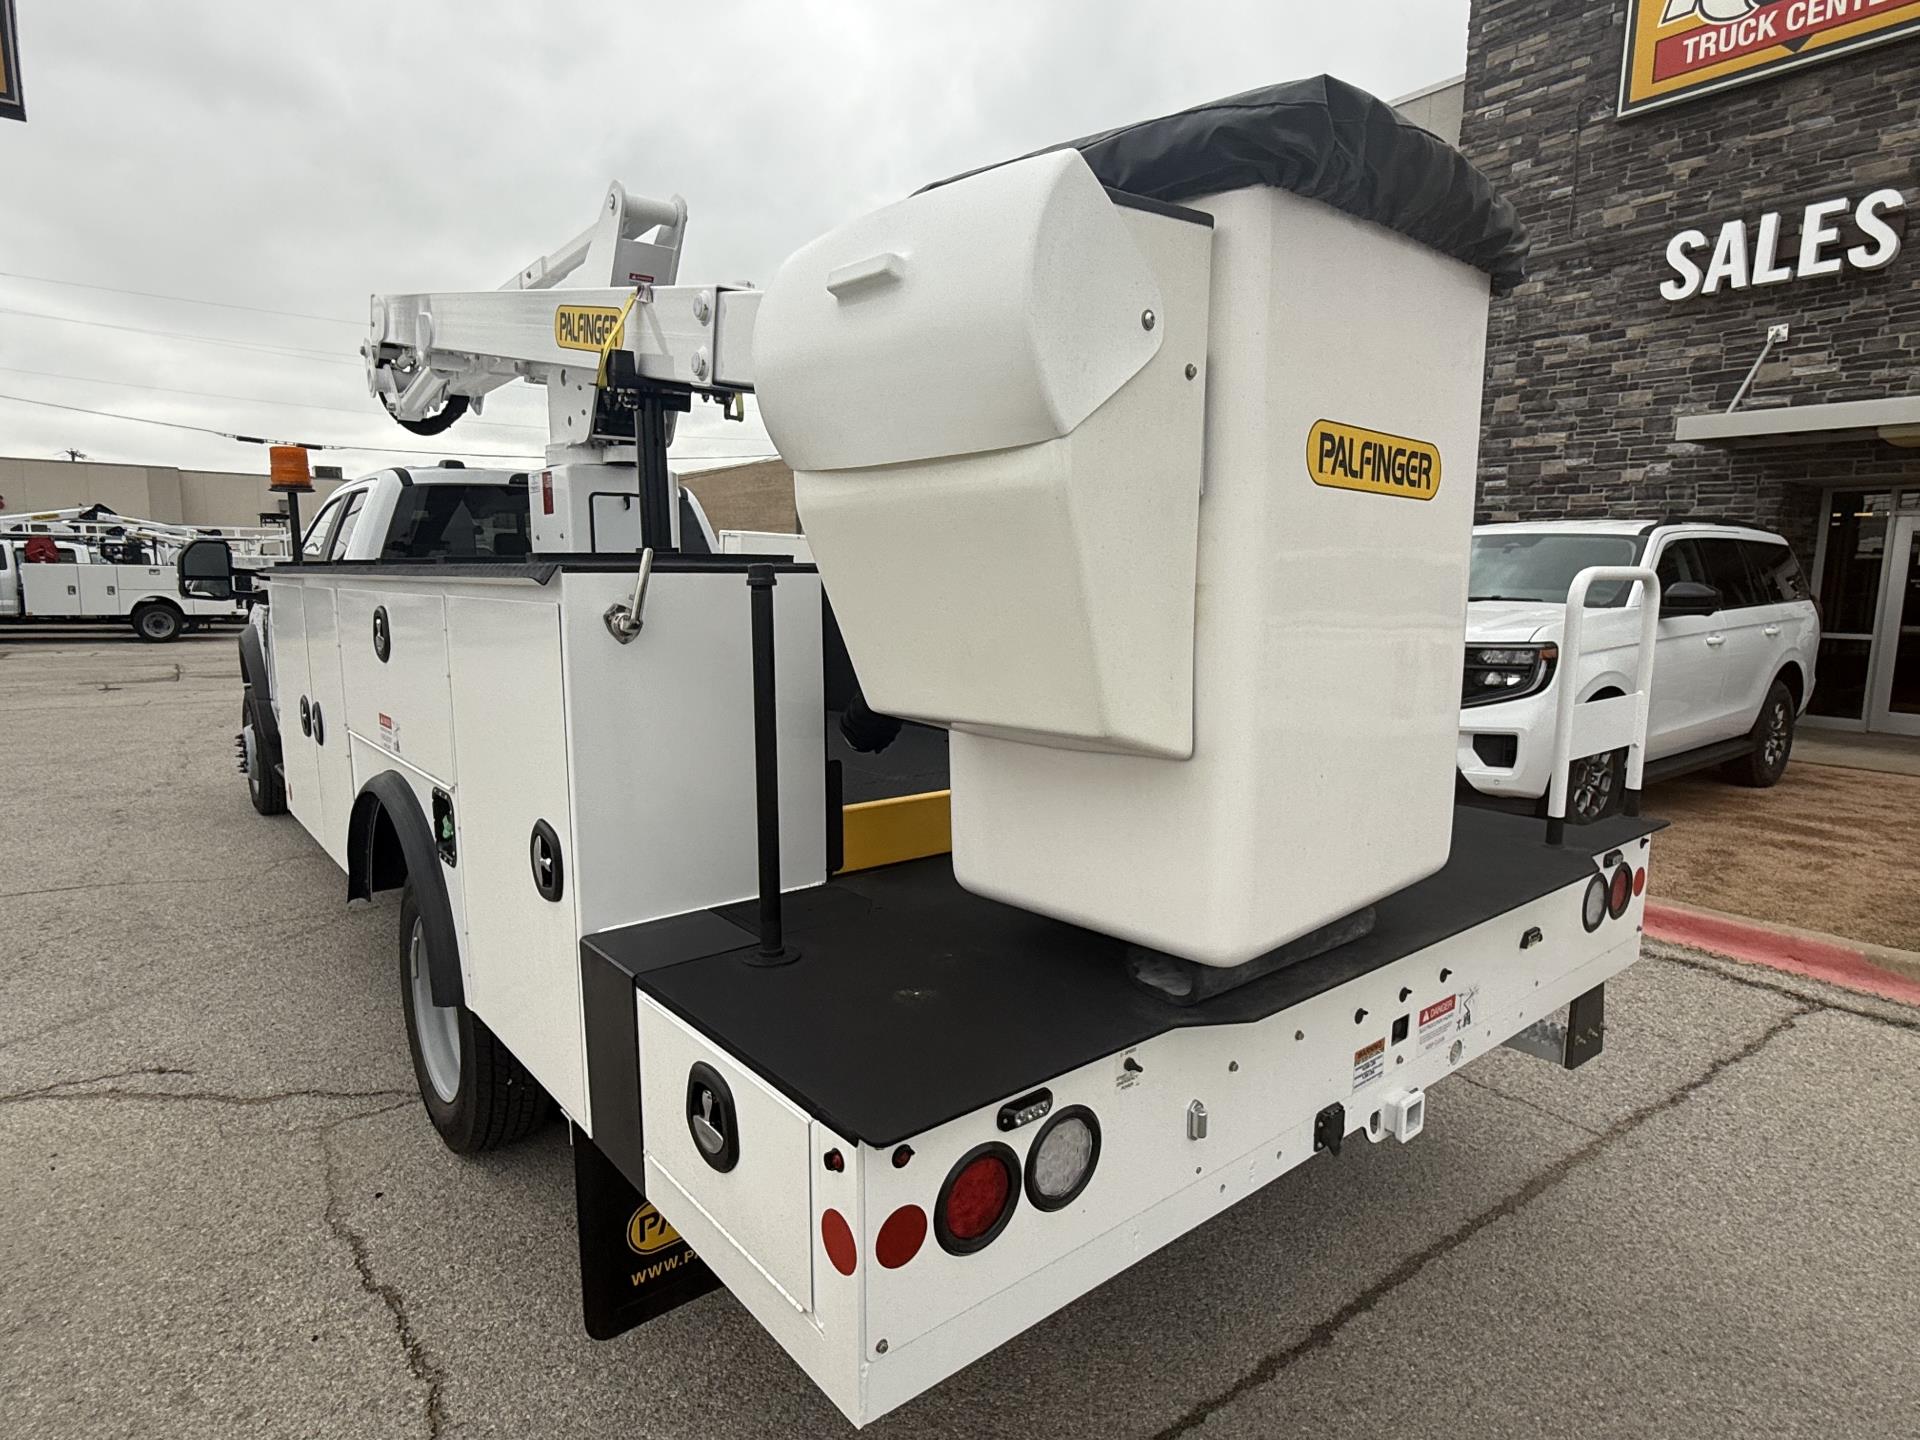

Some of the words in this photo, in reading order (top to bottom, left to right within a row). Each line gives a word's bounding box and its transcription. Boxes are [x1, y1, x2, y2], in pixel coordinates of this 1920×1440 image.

[1682, 9, 1779, 64] TRUCK
[1786, 0, 1888, 31] CEN
[1659, 189, 1906, 302] SALES
[1318, 431, 1433, 490] PALFINGER
[631, 1249, 698, 1287] WWW.P
